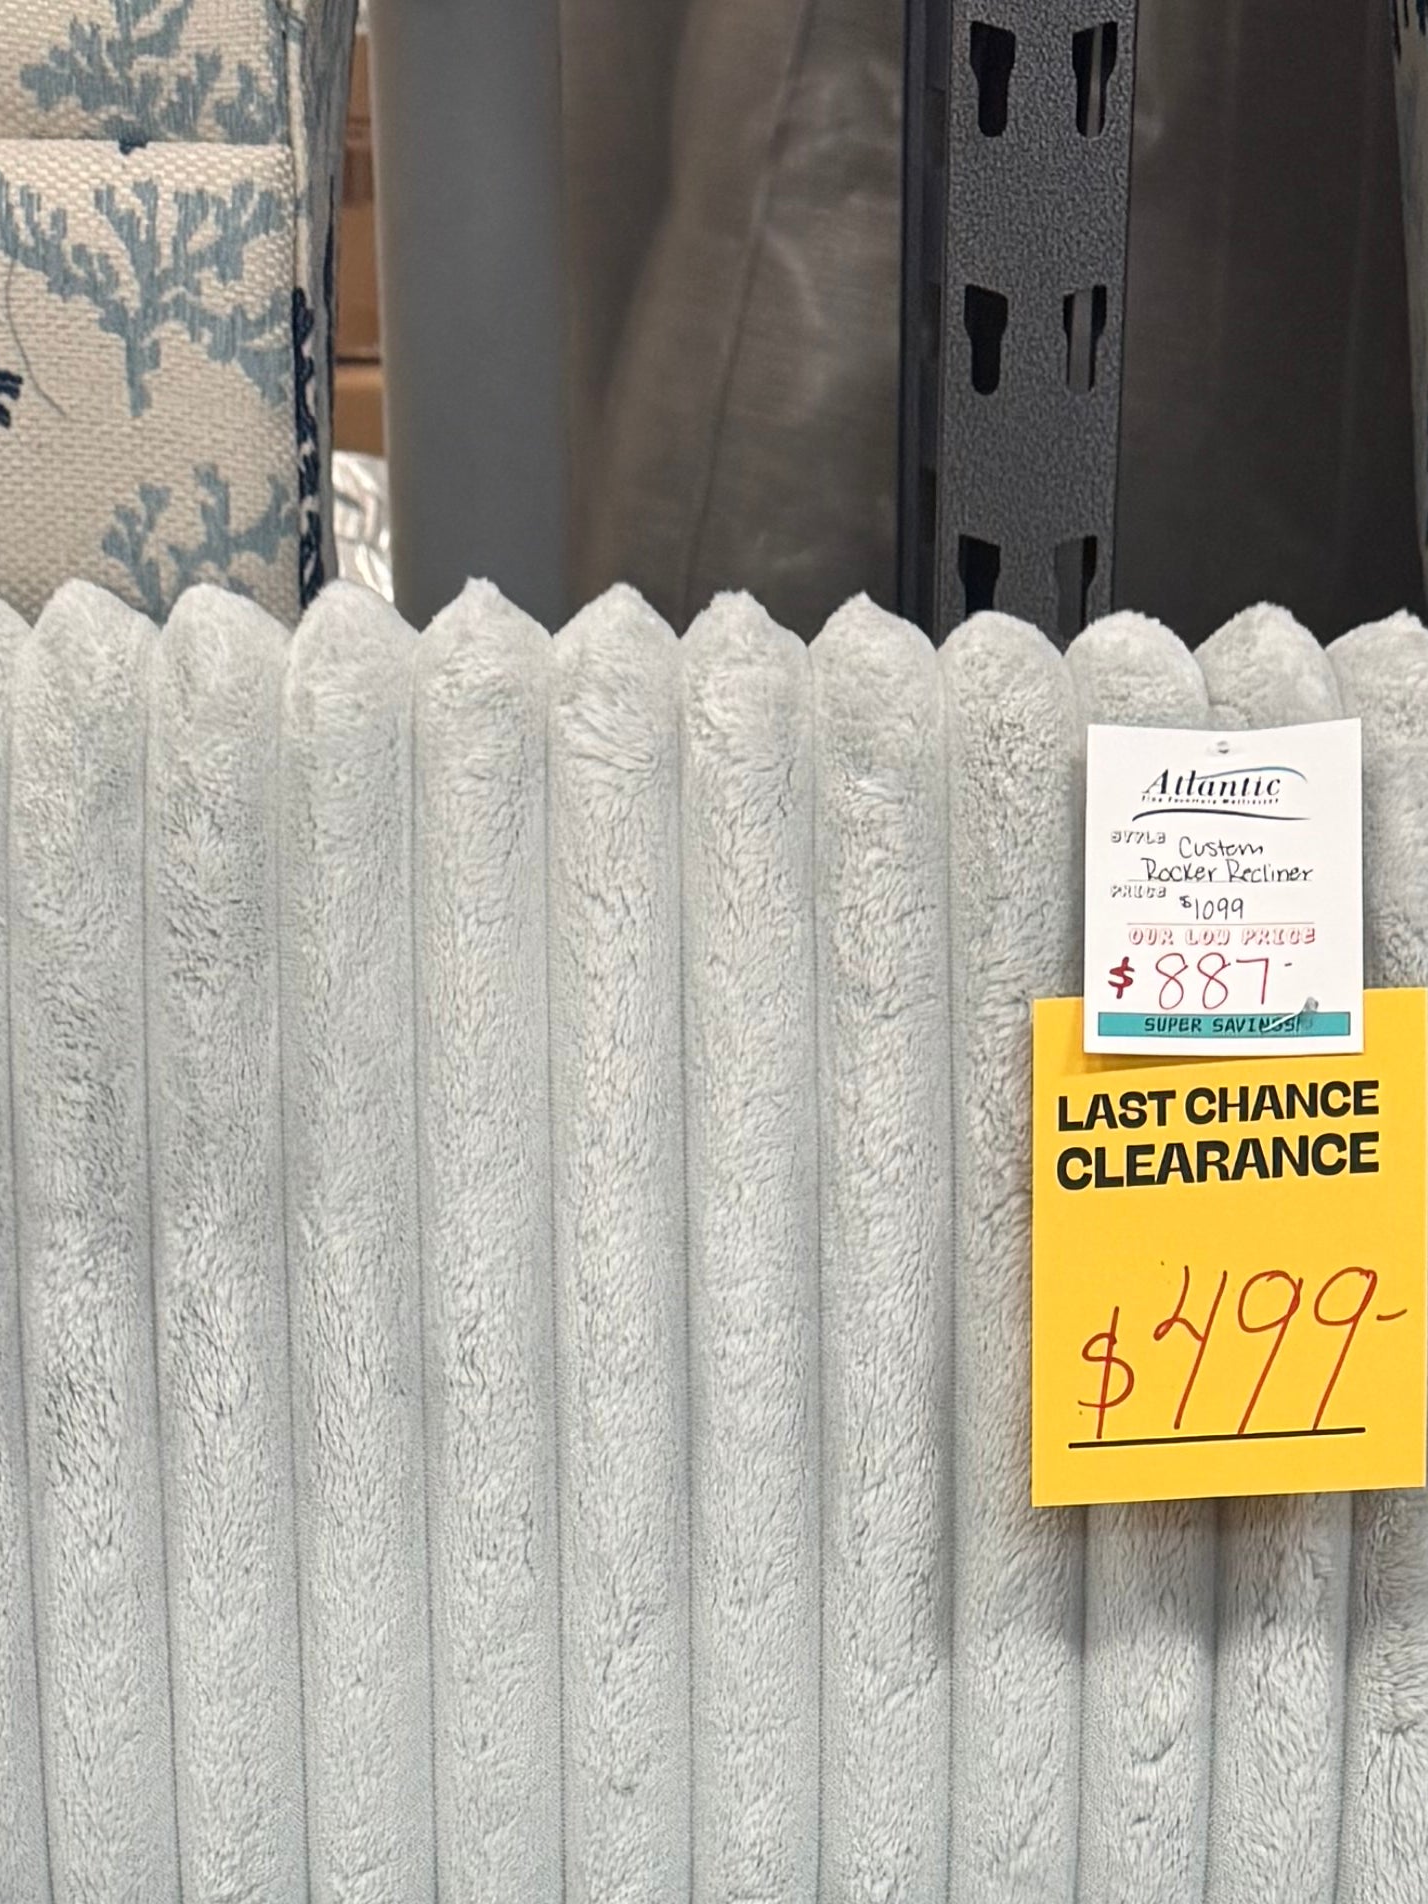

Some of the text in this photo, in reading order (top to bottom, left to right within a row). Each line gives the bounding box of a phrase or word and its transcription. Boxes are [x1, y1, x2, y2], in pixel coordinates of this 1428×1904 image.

[1142, 769, 1281, 797] Atlantic
[1179, 836, 1263, 858] Custom
[1141, 857, 1314, 883] Rocker Recliner
[1179, 895, 1244, 920] $1099
[1129, 927, 1315, 945] OUR LOW PRICE
[1144, 1017, 1202, 1032] SUPER
[1057, 1080, 1380, 1132] LAST CHANCE
[1056, 1131, 1380, 1190] CLEARANCE
